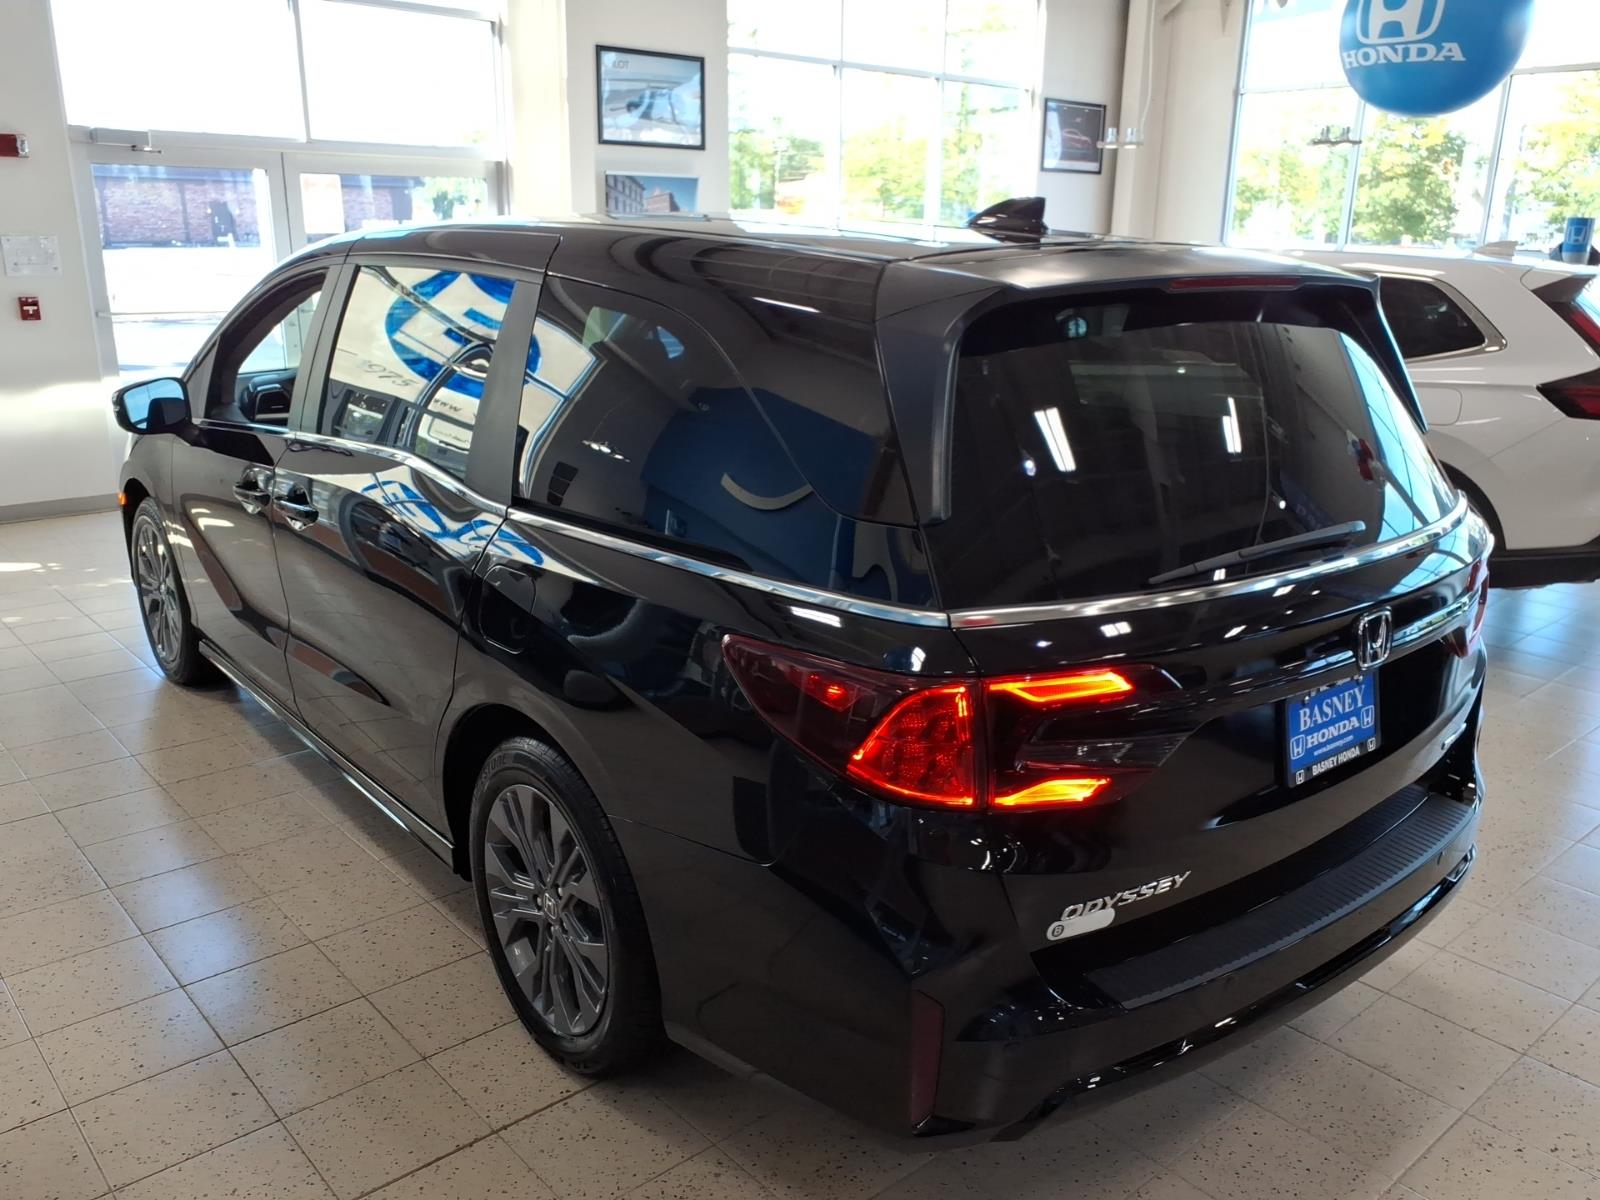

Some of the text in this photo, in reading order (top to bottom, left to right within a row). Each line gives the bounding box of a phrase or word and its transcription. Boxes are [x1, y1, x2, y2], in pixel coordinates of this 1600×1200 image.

[1341, 42, 1466, 69] HONDA
[1299, 685, 1365, 731] BASNEY
[1306, 716, 1360, 749] HONDA
[1312, 755, 1337, 776] BASNEY
[1338, 746, 1360, 764] HONDA
[1061, 871, 1191, 921] ODYSSEY
